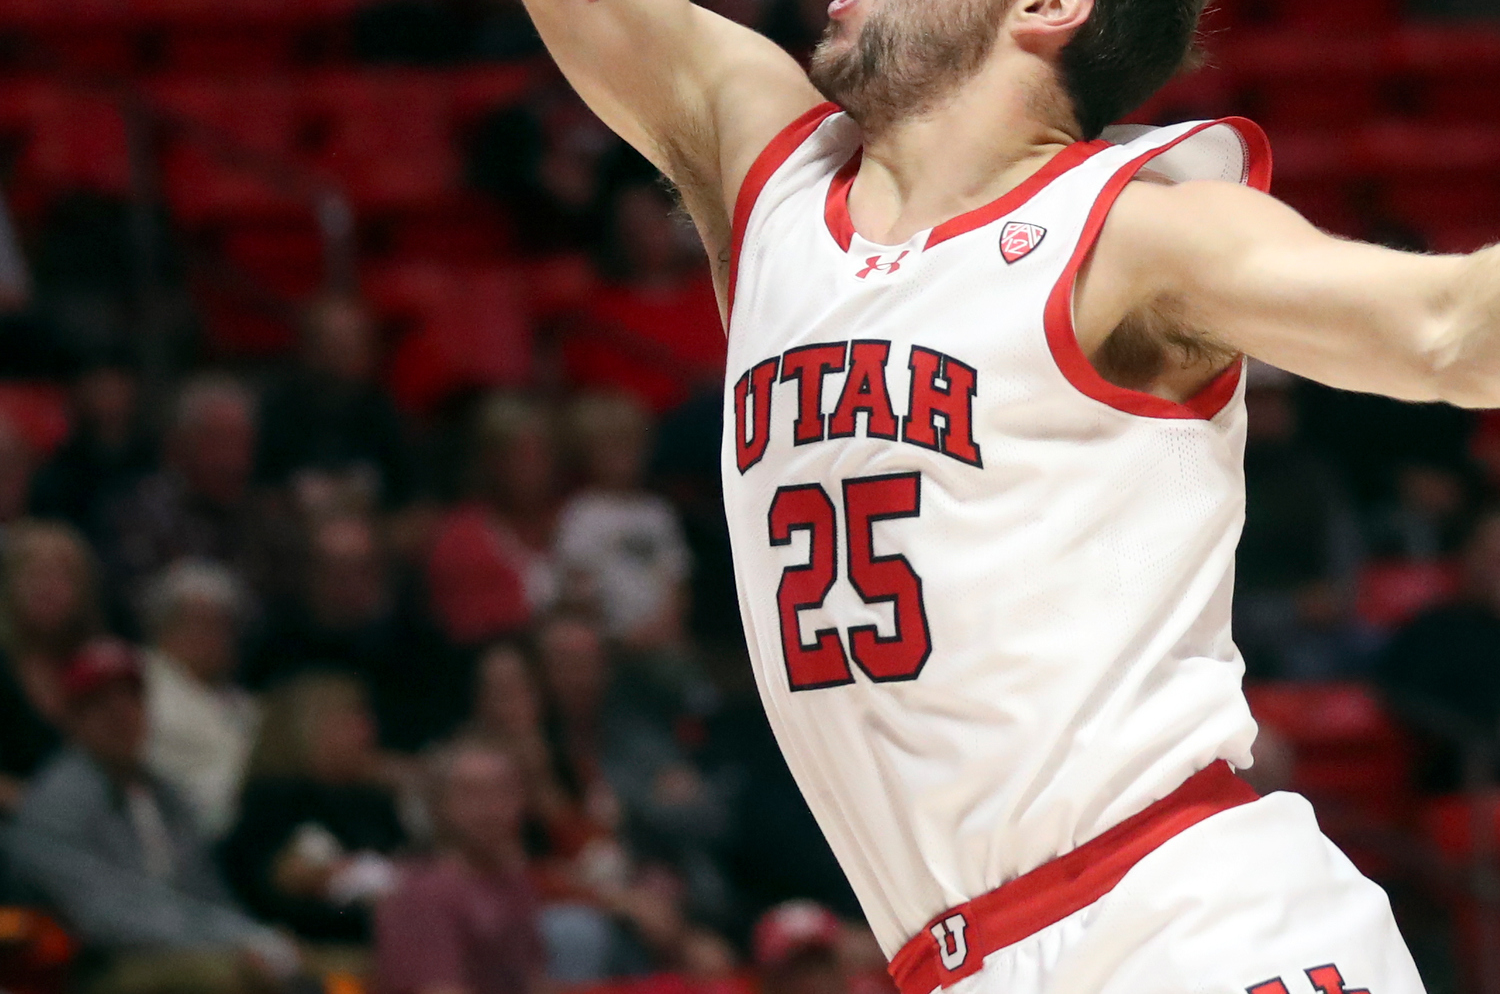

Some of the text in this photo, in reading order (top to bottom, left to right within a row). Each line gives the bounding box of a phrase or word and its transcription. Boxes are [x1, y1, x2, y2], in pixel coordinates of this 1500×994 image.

[1001, 222, 1045, 249] PAC
[1004, 237, 1028, 255] 12
[734, 339, 984, 476] UTAH
[768, 471, 933, 692] 25
[930, 913, 968, 972] U
